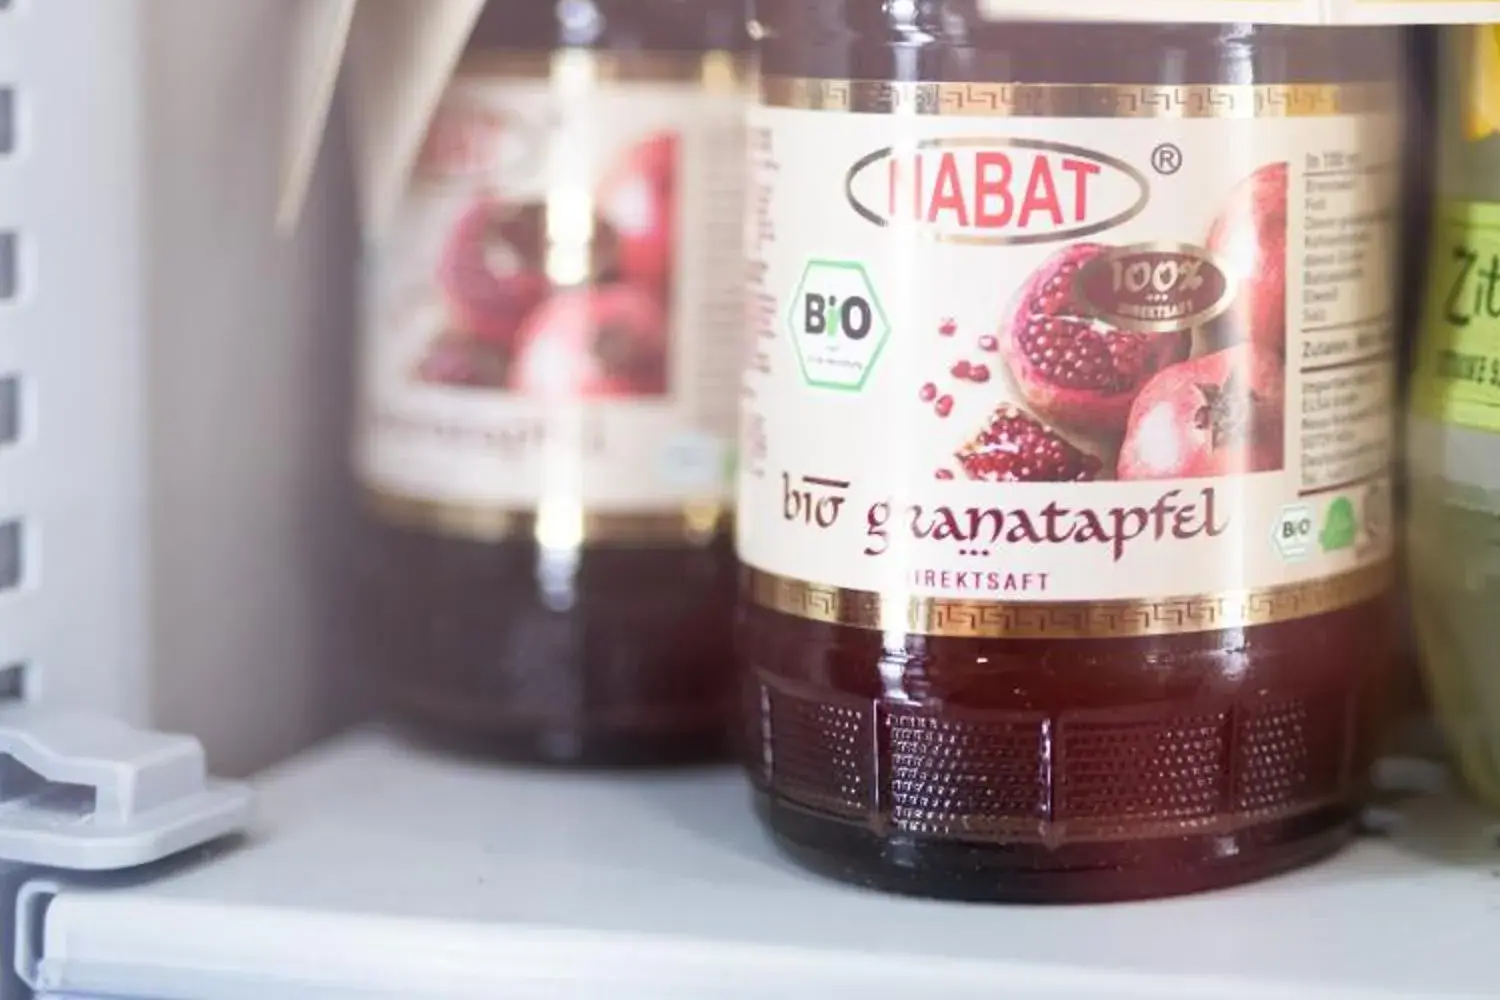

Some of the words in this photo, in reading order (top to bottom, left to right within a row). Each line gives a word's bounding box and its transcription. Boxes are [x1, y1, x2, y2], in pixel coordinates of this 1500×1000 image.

[1112, 259, 1204, 293] 100%
[805, 293, 872, 340] BiO
[908, 571, 1052, 592] IREKTSAFT
